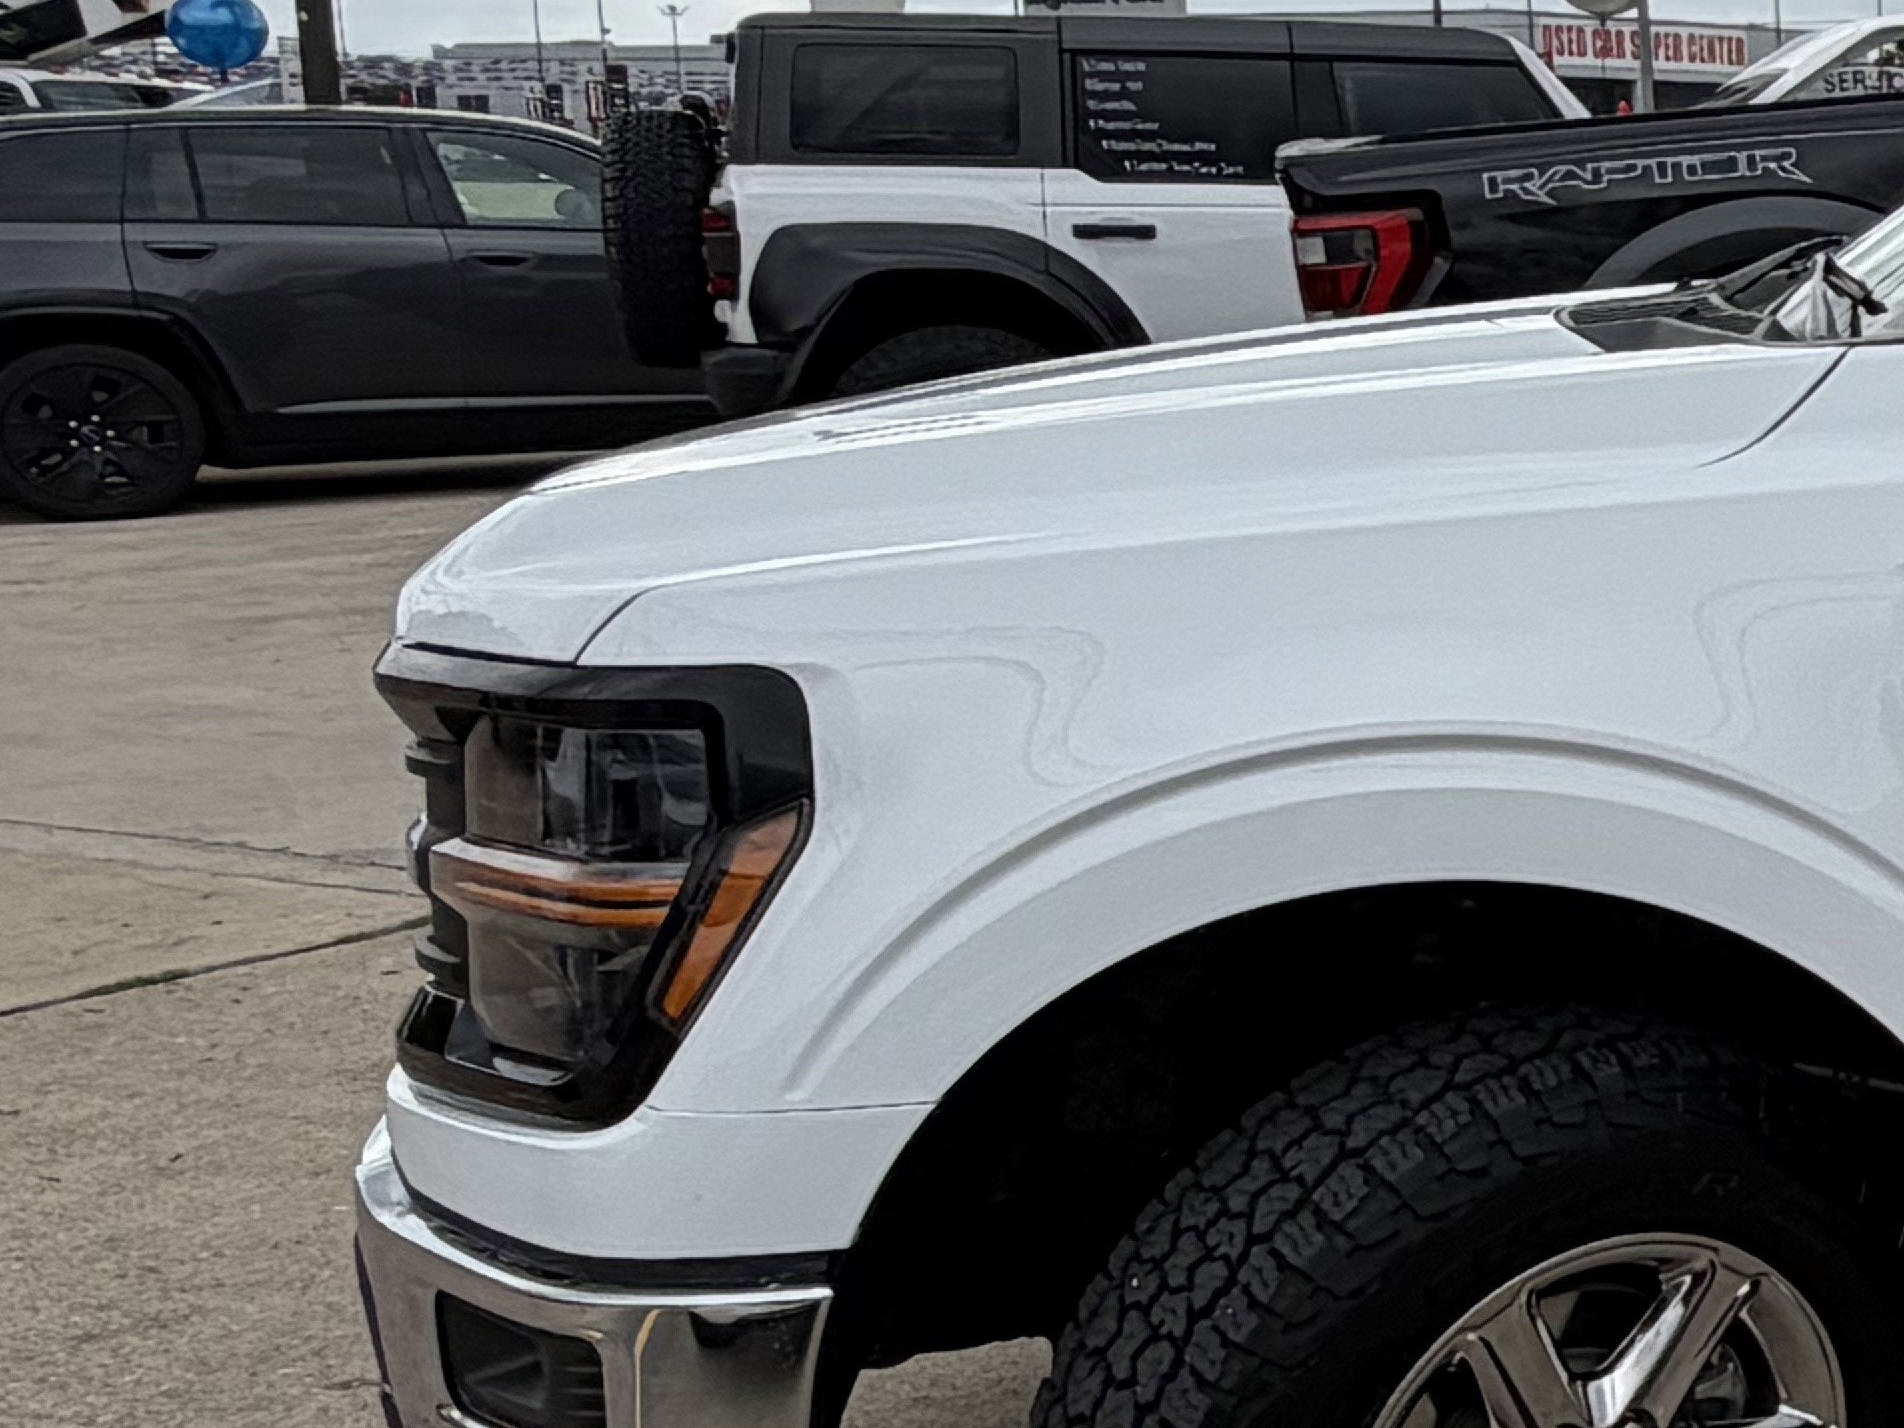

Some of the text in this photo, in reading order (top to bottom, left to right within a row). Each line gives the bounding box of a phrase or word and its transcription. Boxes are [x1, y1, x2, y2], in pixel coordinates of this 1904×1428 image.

[1542, 25, 1746, 66] USED CAR SPER CENTER
[1482, 146, 1814, 205] RAPTOR
